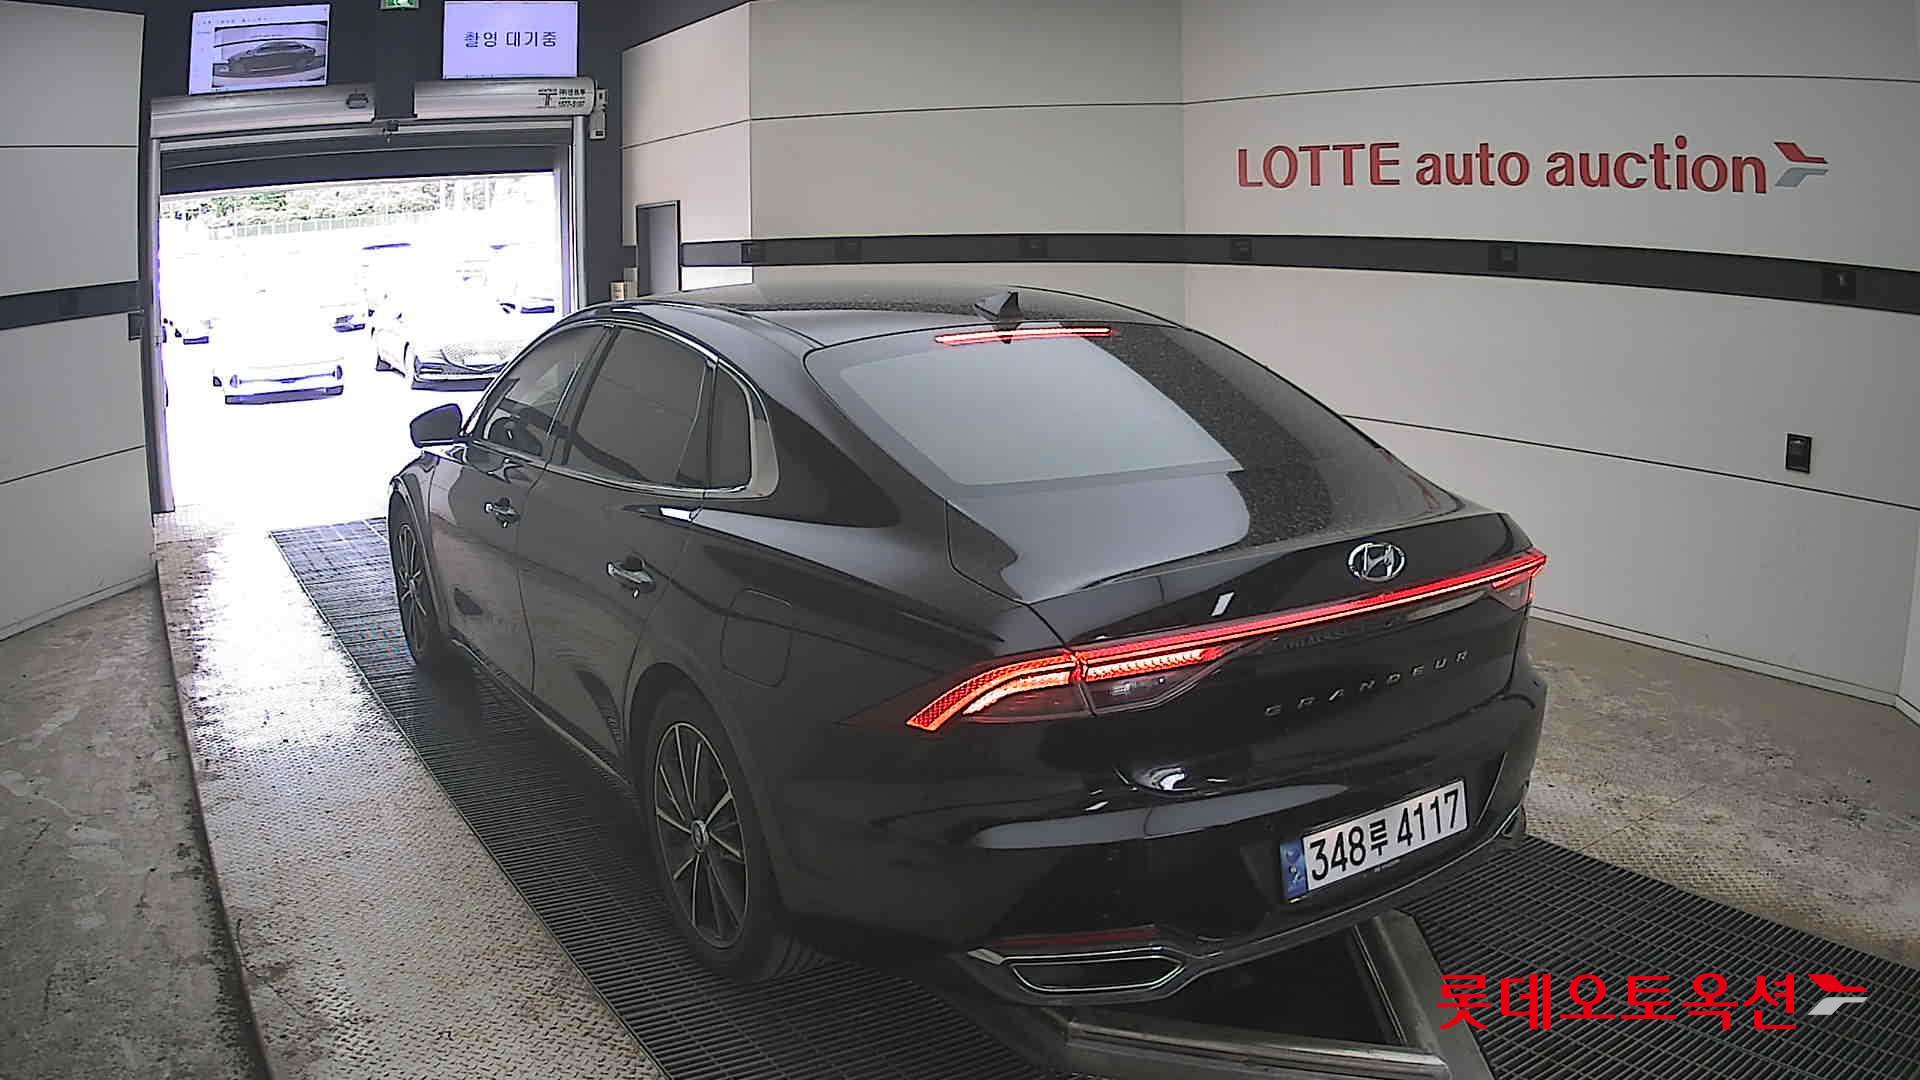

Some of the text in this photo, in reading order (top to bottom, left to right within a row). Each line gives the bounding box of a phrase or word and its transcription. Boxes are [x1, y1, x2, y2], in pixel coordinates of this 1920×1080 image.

[464, 31, 557, 48] 촬영 대기중
[1238, 135, 1767, 193] LOTTE auto auction
[1264, 650, 1468, 716] GRANDEUR
[1309, 789, 1459, 880] 348루 4117
